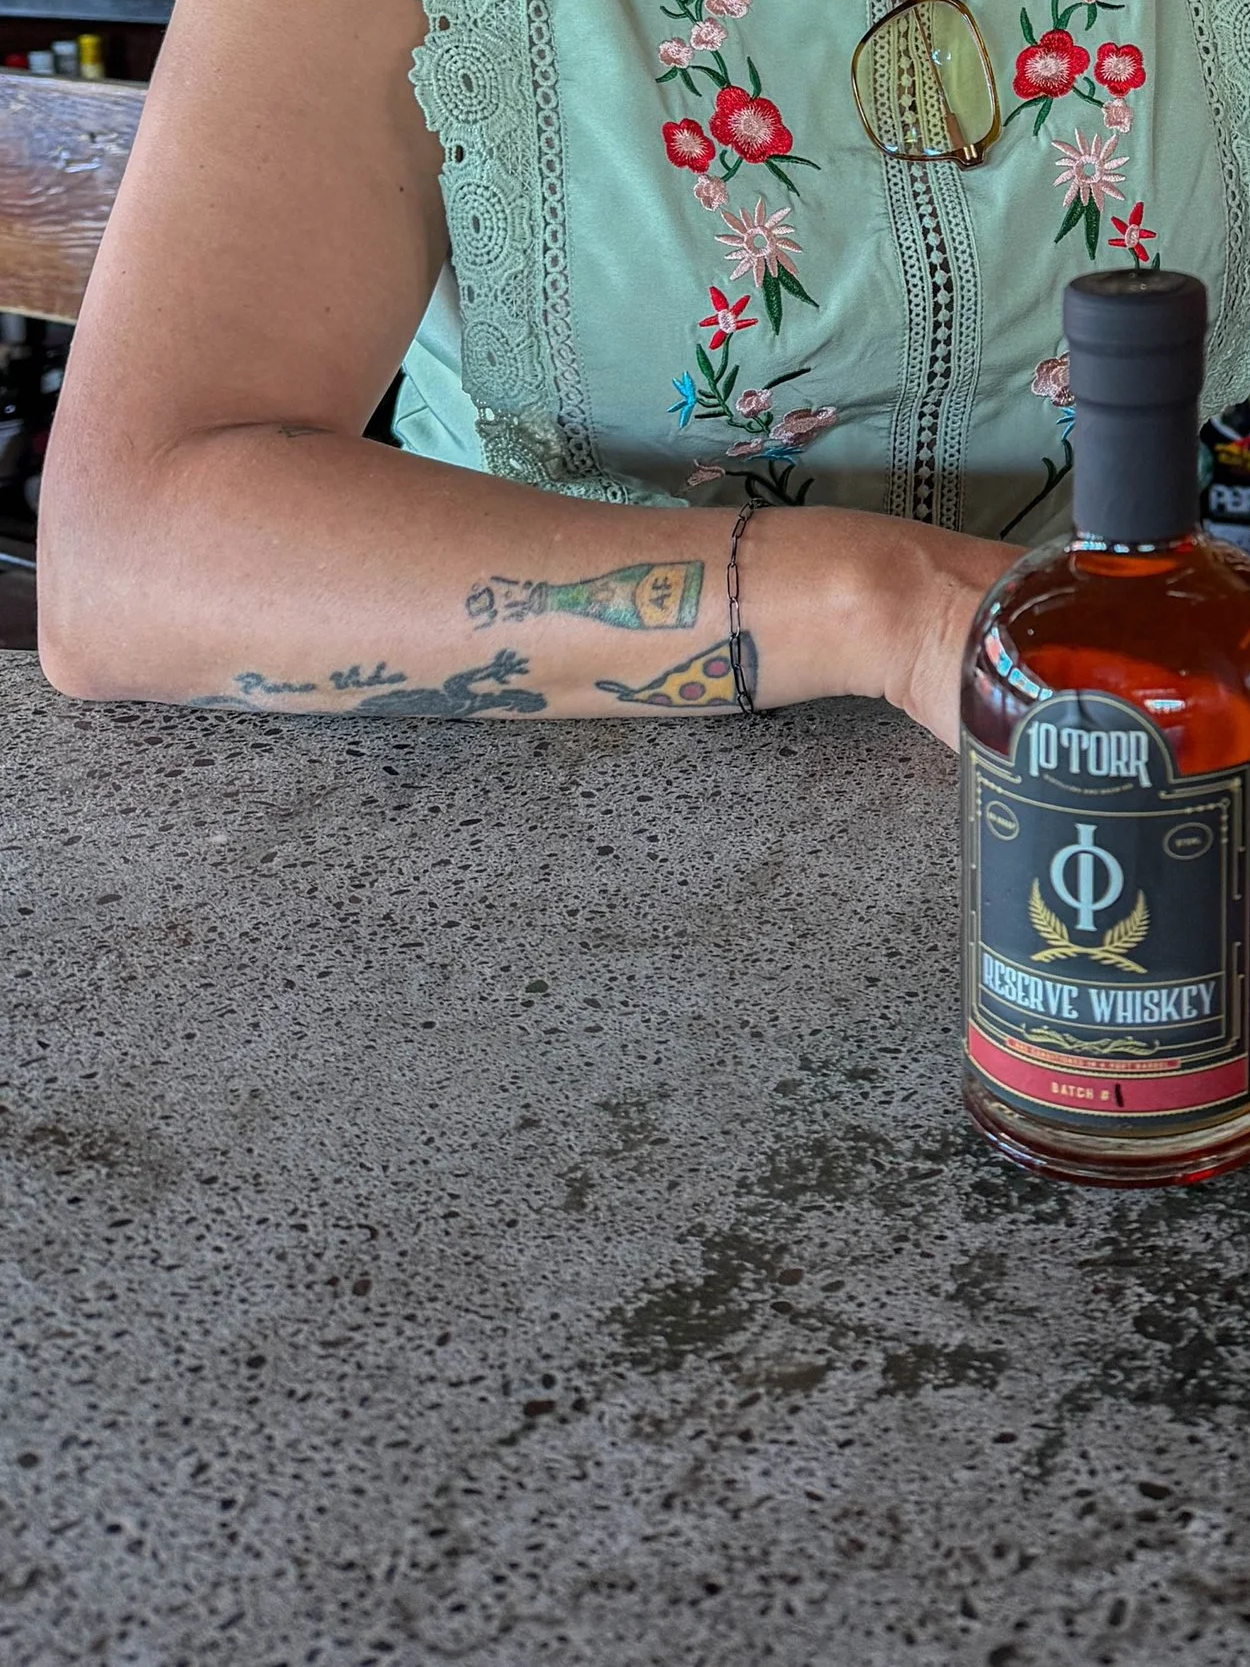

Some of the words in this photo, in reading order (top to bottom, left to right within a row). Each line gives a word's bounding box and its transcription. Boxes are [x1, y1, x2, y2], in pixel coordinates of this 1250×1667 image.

[1027, 720, 1056, 778] 10
[1058, 727, 1153, 789] TORR
[981, 952, 1080, 1021] RESERVE
[1088, 979, 1218, 1025] WHISKEY
[1050, 1081, 1094, 1100] BATCH
